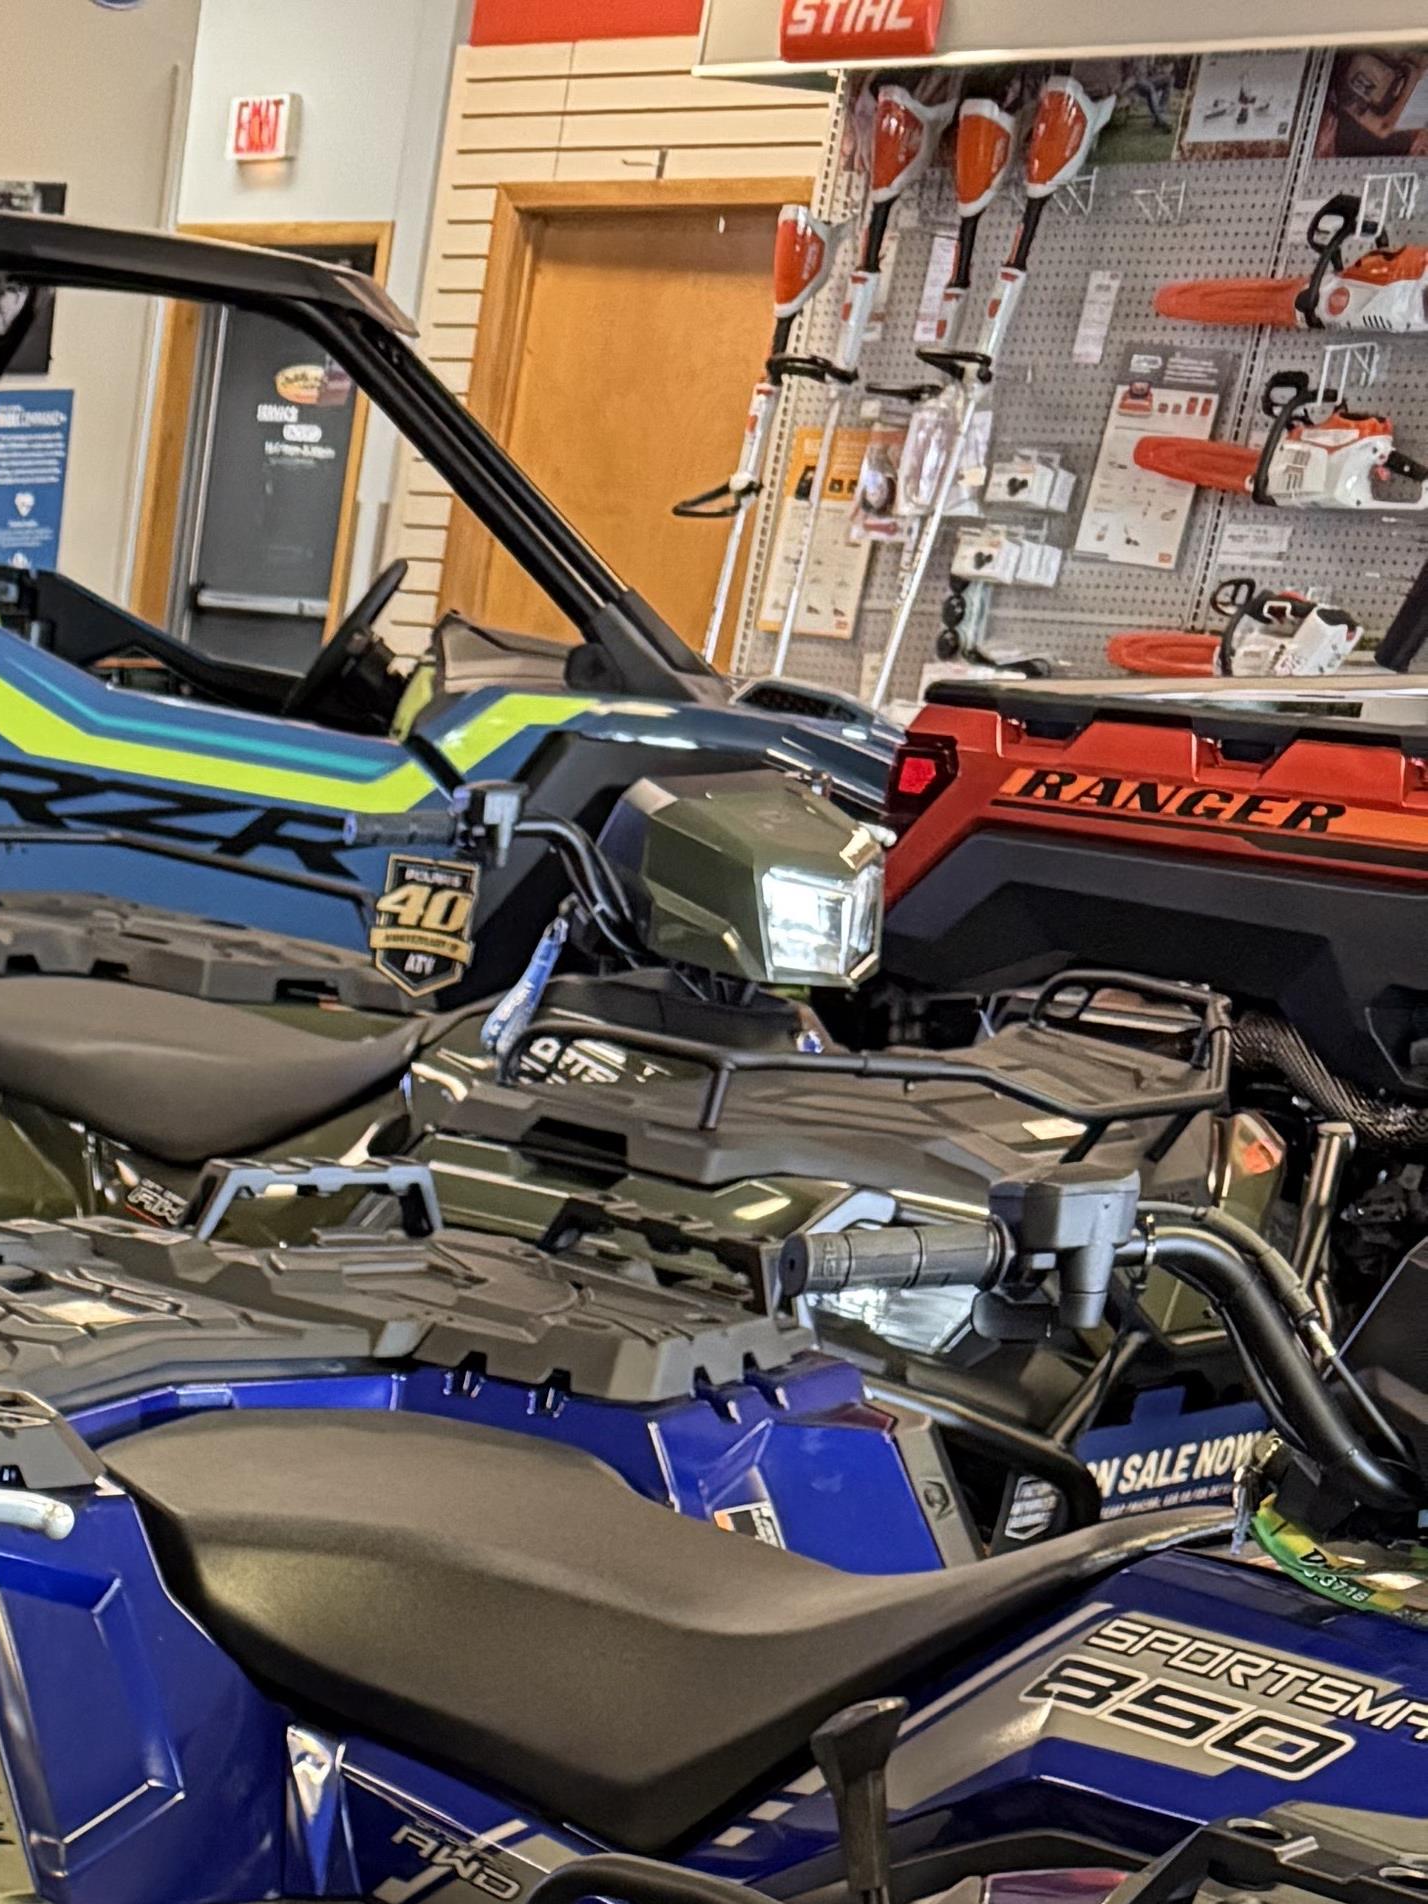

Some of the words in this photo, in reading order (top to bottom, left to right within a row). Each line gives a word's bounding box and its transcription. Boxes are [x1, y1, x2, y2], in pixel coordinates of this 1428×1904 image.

[787, 0, 913, 35] STIHL
[1017, 769, 1346, 832] RANGER
[376, 884, 472, 932] 40
[1117, 1443, 1201, 1496] SALE
